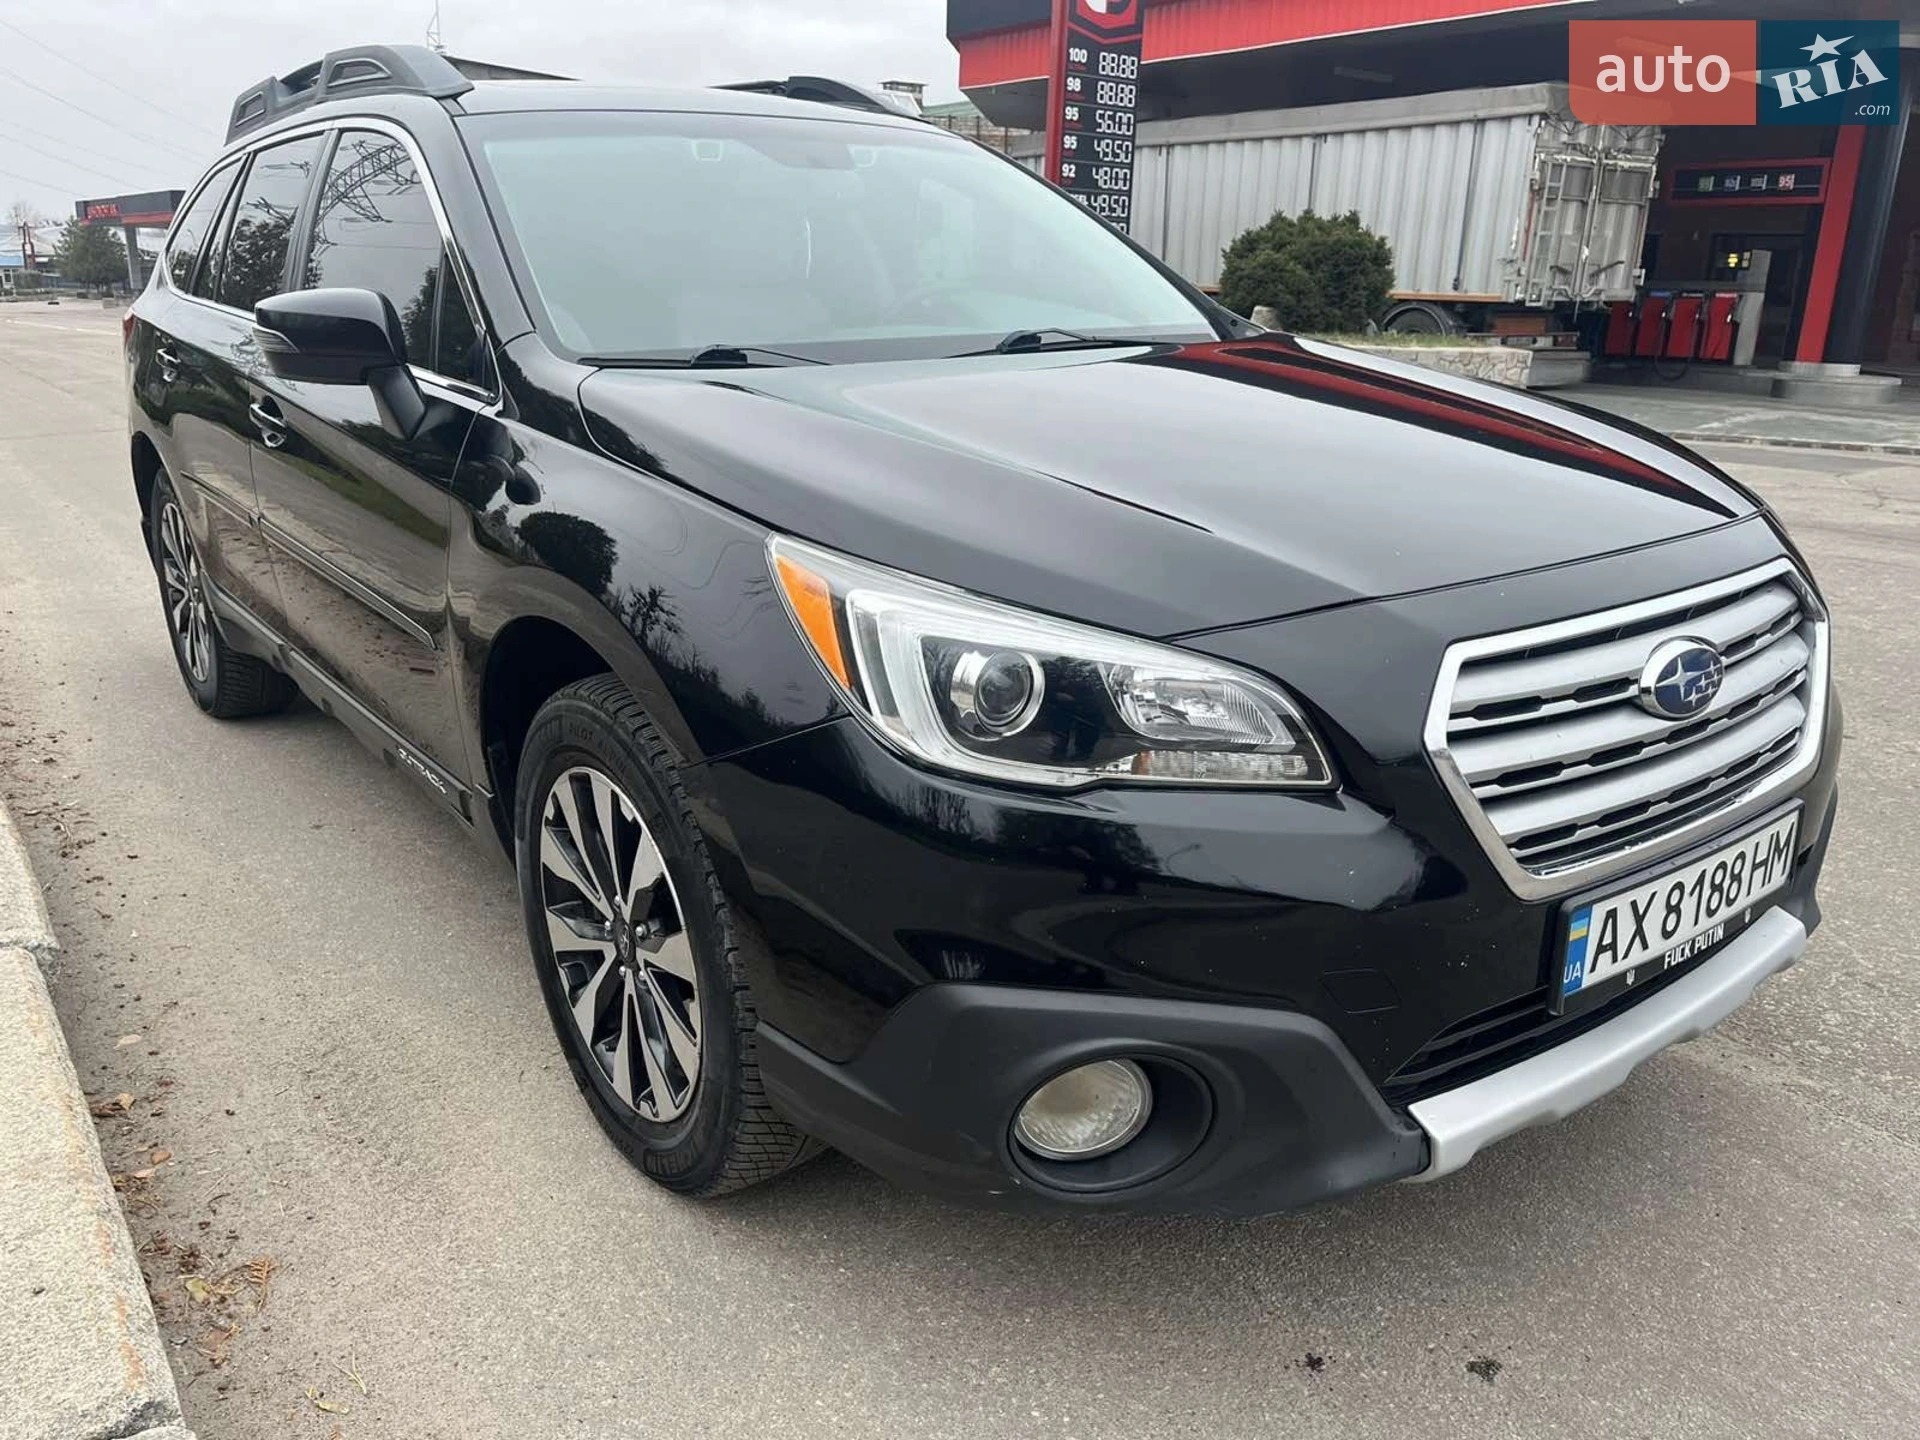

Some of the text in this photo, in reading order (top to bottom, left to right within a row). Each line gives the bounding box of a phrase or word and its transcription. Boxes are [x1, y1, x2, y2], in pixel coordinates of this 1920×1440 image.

[1068, 47, 1138, 79] 100 88.88
[1066, 77, 1136, 107] 98 88.88
[1065, 107, 1134, 135] 95 56.00
[1063, 135, 1132, 163] 95 49.50
[1062, 164, 1130, 190] 92 48.00
[1091, 194, 1129, 217] 49.50
[1589, 821, 1795, 974] AX 8188 HM
[1663, 923, 1725, 970] FUCK PUTIN
[1563, 964, 1582, 984] UA
